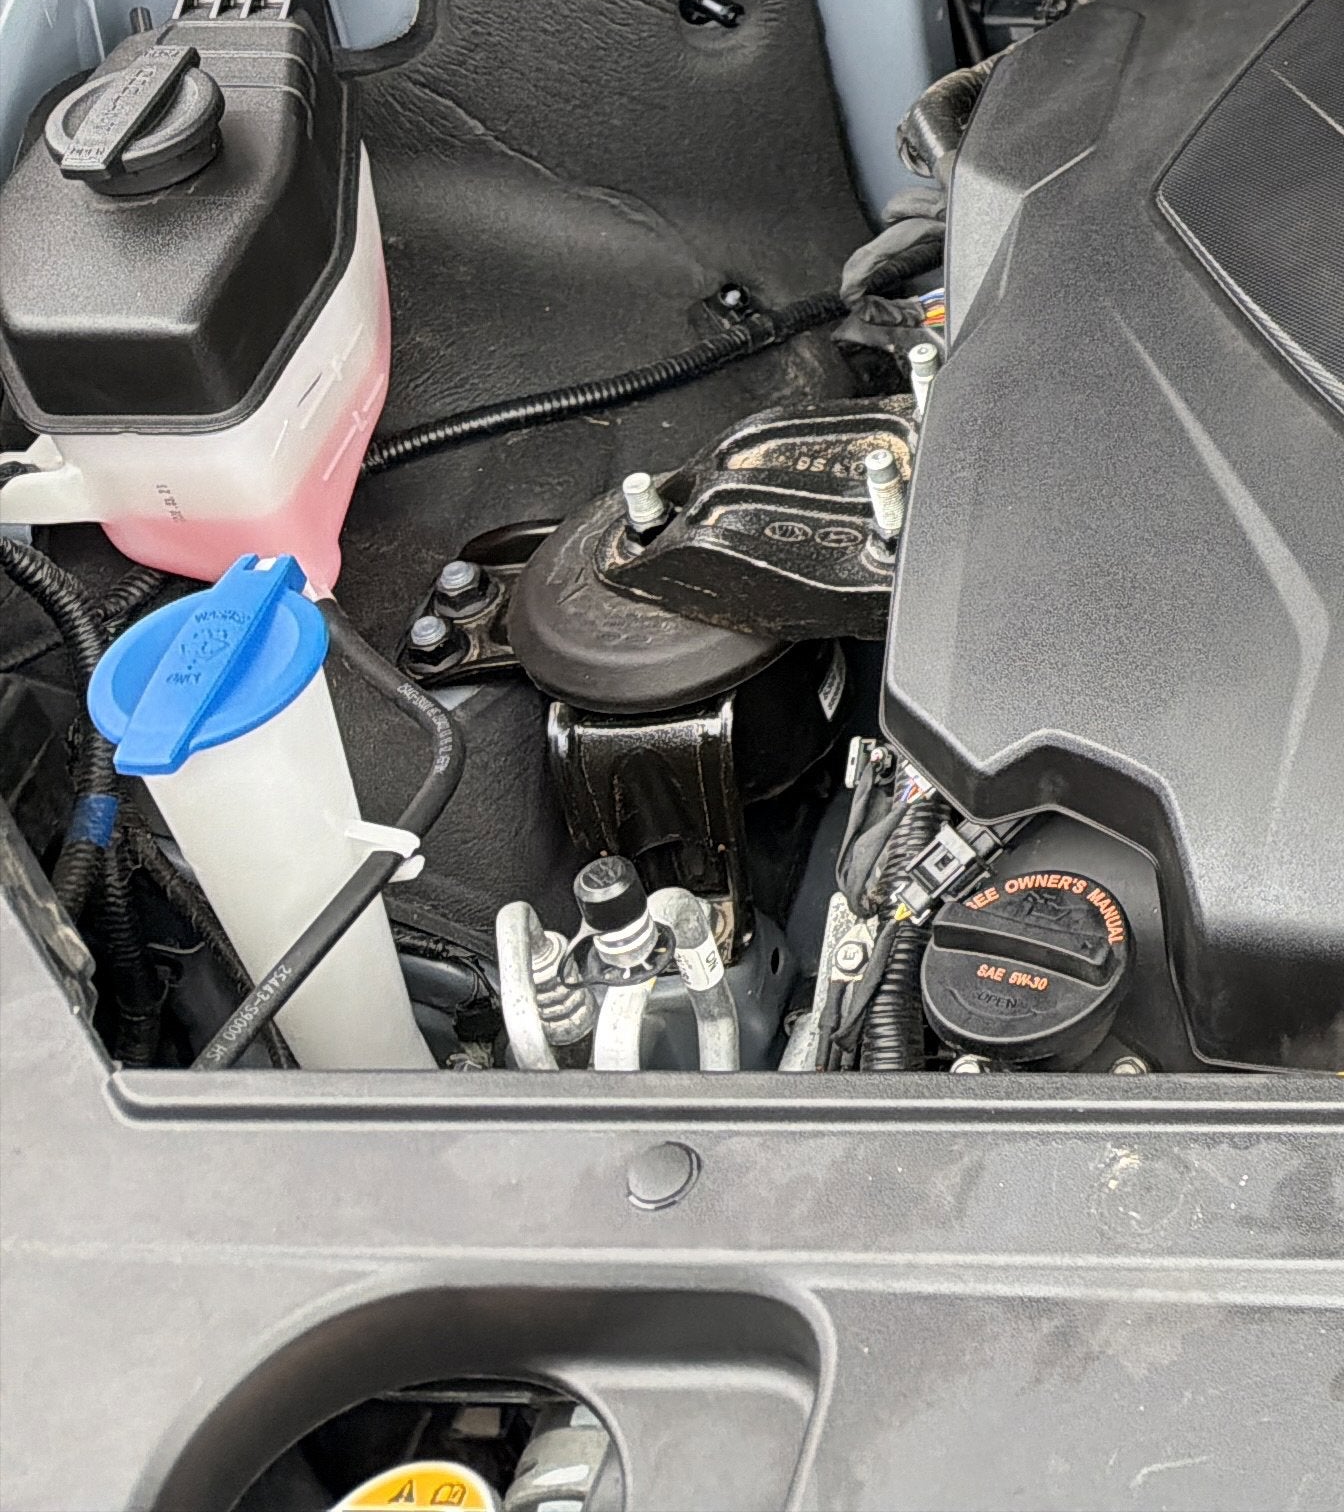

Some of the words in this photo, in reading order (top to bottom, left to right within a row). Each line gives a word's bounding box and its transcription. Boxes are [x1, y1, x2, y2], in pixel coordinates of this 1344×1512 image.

[1005, 874, 1088, 894] OWNER'S
[1086, 888, 1124, 946] MANUAL
[977, 963, 1007, 983] SAE
[1008, 971, 1049, 991] 5W-30
[977, 990, 1018, 1009] OPEN
